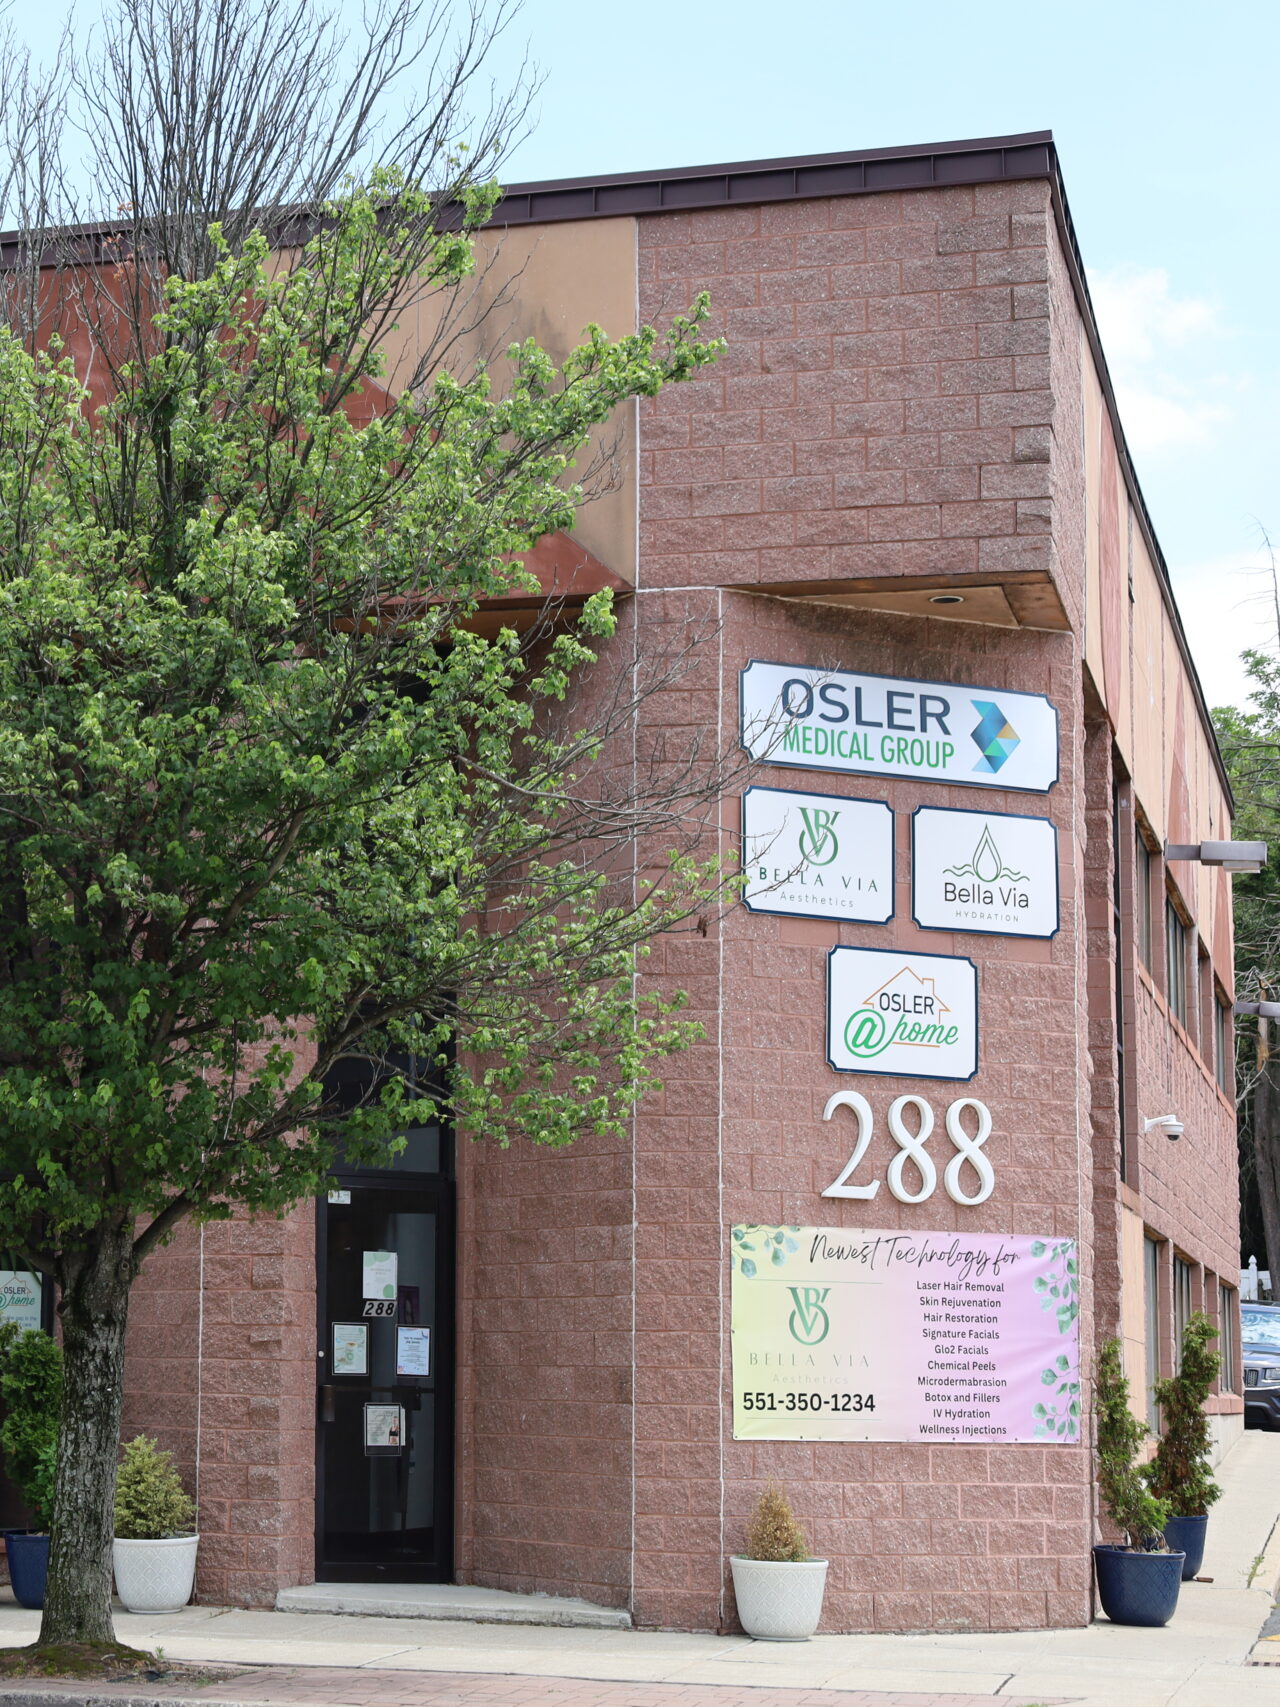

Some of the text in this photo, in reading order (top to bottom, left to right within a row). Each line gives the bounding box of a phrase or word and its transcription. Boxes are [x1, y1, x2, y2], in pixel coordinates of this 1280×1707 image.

[781, 678, 952, 736] OSLER
[783, 724, 955, 769] MEDICAL GROUP
[759, 867, 878, 893] BELLA VIA
[780, 891, 854, 908] Aesthetics
[944, 882, 1029, 909] Bella Via
[955, 910, 1019, 923] HYDRATION
[879, 992, 934, 1016] OSLER
[844, 1008, 959, 1059] @home
[821, 1090, 996, 1207] 288
[810, 1233, 1021, 1281] Newest Technology for
[3, 1286, 26, 1295] OSLER
[916, 1280, 1005, 1292] Laser Hair Removal
[364, 1302, 395, 1316] 288
[919, 1296, 1001, 1309] Skin Rejuvenation
[923, 1312, 998, 1324] Hair Restoration
[922, 1328, 1000, 1340] Signature Facials
[934, 1344, 989, 1355] Glo2 Facials
[749, 1352, 870, 1368] BELLA VIA
[927, 1360, 996, 1371] Chemical Peels
[917, 1376, 1007, 1387] Microdermabrasion
[742, 1392, 876, 1412] 551-350-1234
[924, 1392, 1001, 1403] Botox and Fillers
[933, 1408, 991, 1420] IV Hydration
[919, 1424, 1007, 1436] Wellness Injections
